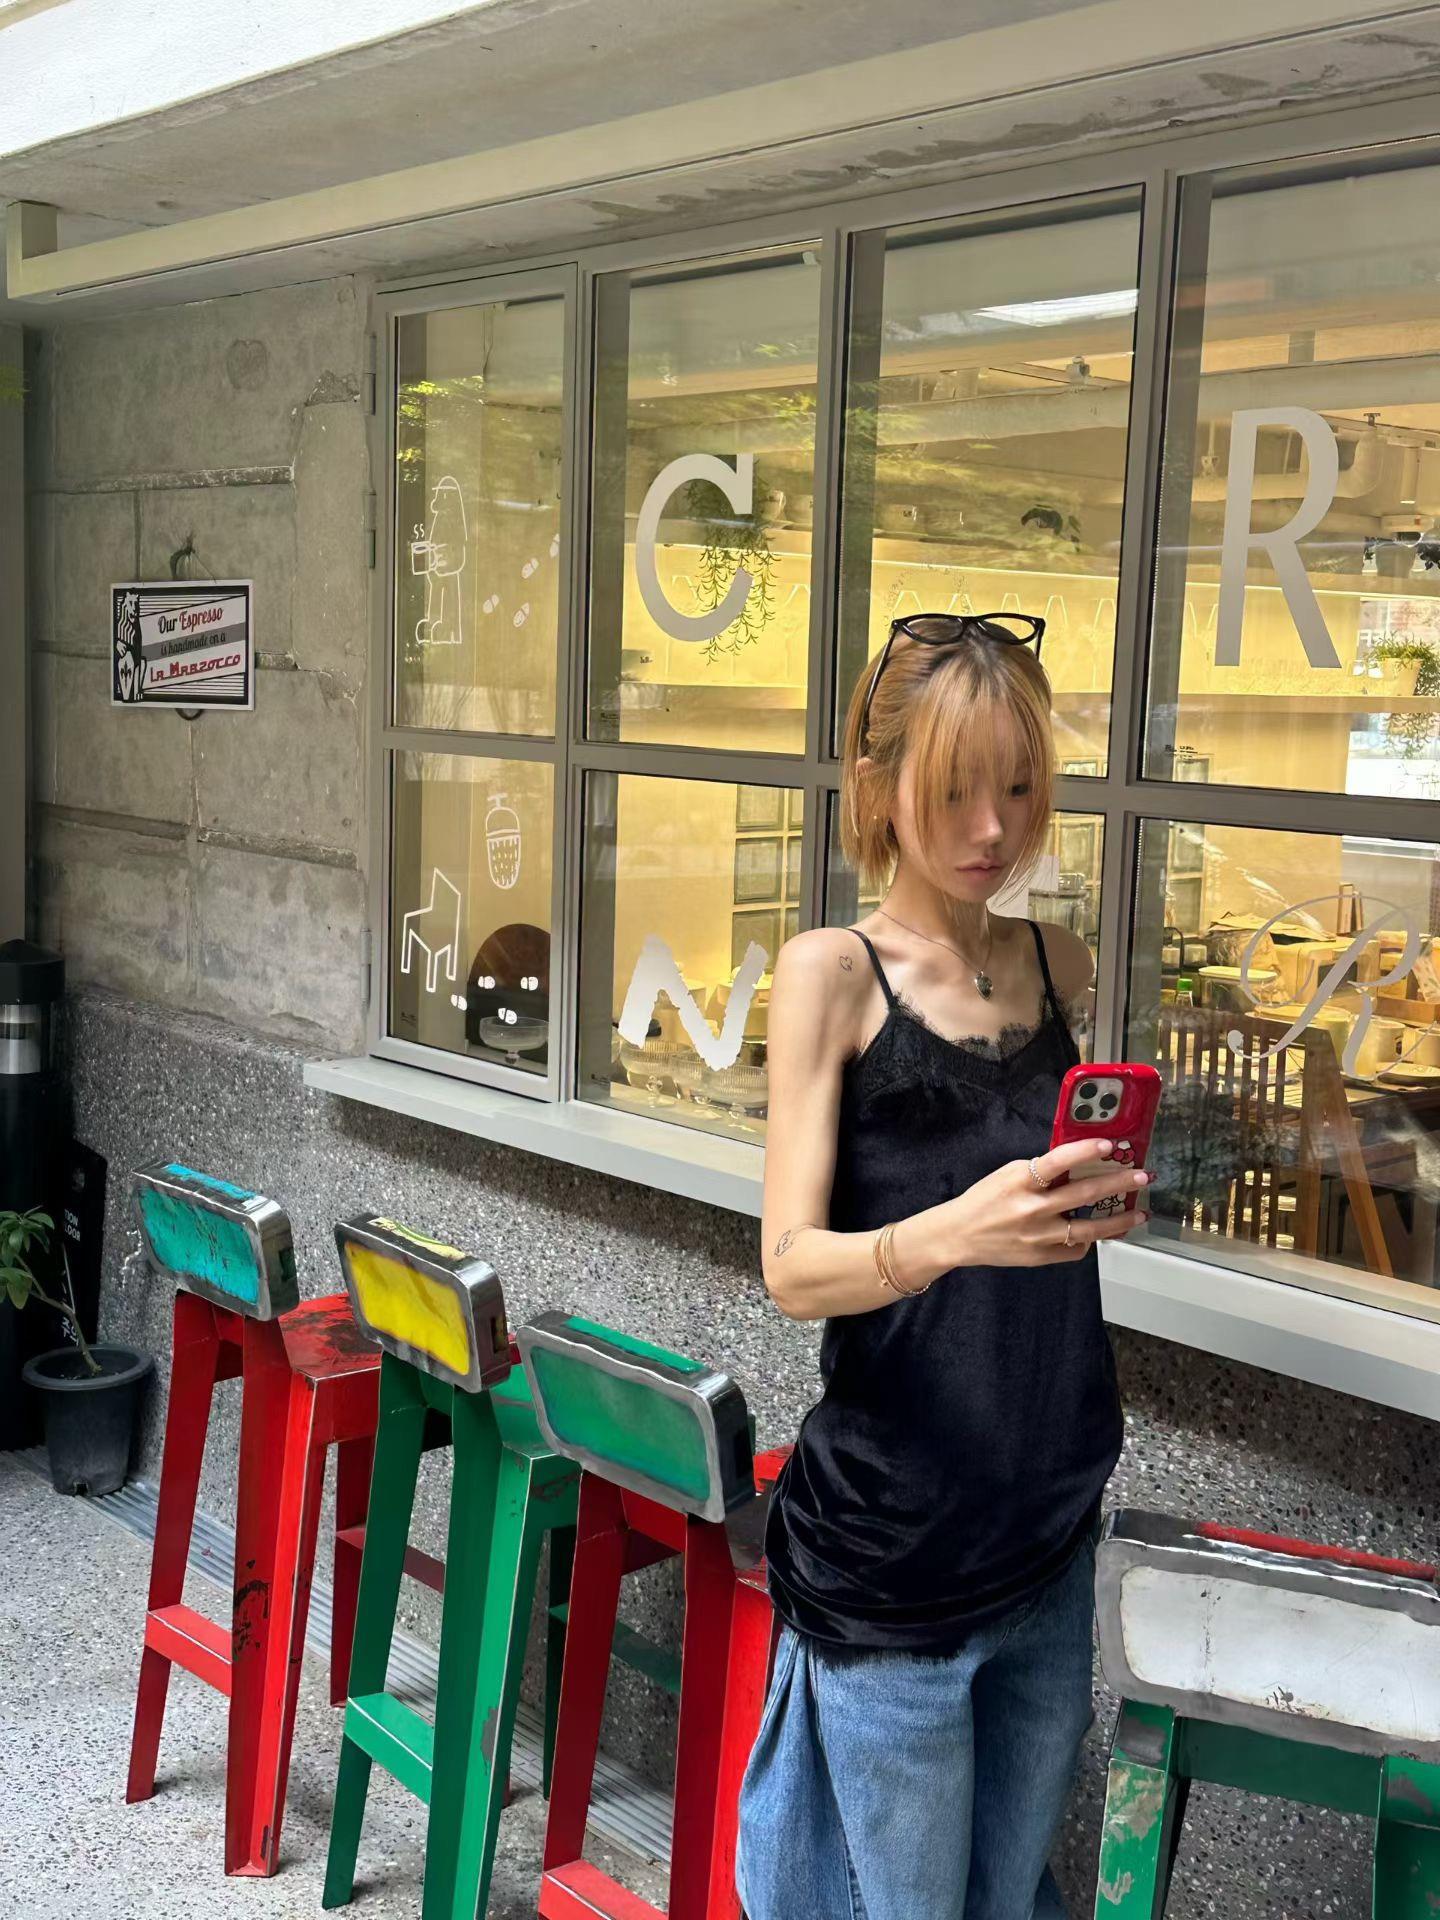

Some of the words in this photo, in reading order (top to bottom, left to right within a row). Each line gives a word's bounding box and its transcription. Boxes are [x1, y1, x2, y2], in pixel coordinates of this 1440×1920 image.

[635, 453, 753, 642] C
[1214, 406, 1342, 669] R
[158, 615, 177, 634] Our
[179, 607, 224, 633] Espresso
[209, 633, 219, 645] on
[618, 933, 769, 1072] N
